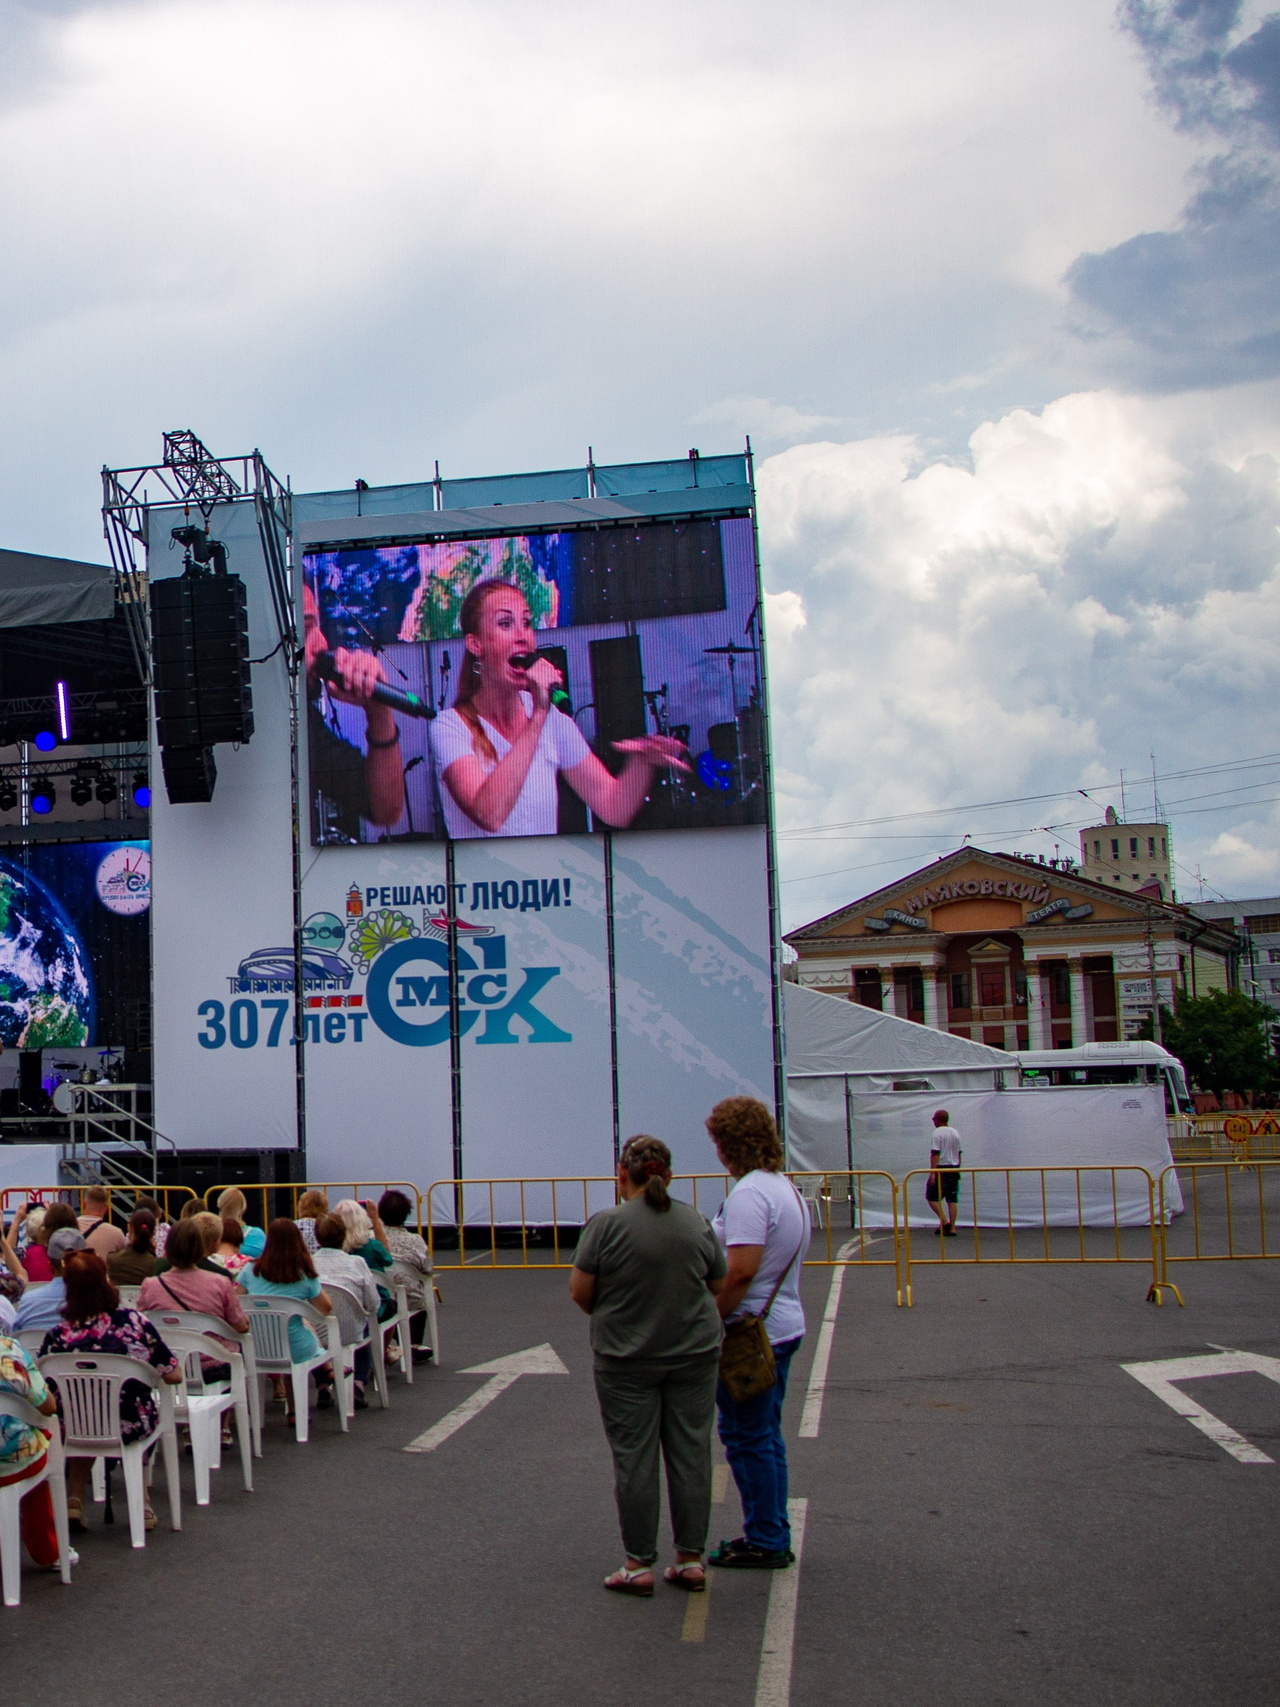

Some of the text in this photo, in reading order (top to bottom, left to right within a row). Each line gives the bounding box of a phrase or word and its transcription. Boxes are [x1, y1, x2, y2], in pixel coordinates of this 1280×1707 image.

[365, 878, 571, 912] РЕШАЮТ ЛЮДИ!
[904, 879, 1052, 914] МАЯКОВСКИЙ
[1033, 899, 1063, 919] ТЕАТР
[893, 911, 920, 926] КИНО
[197, 998, 368, 1049] 307 лет
